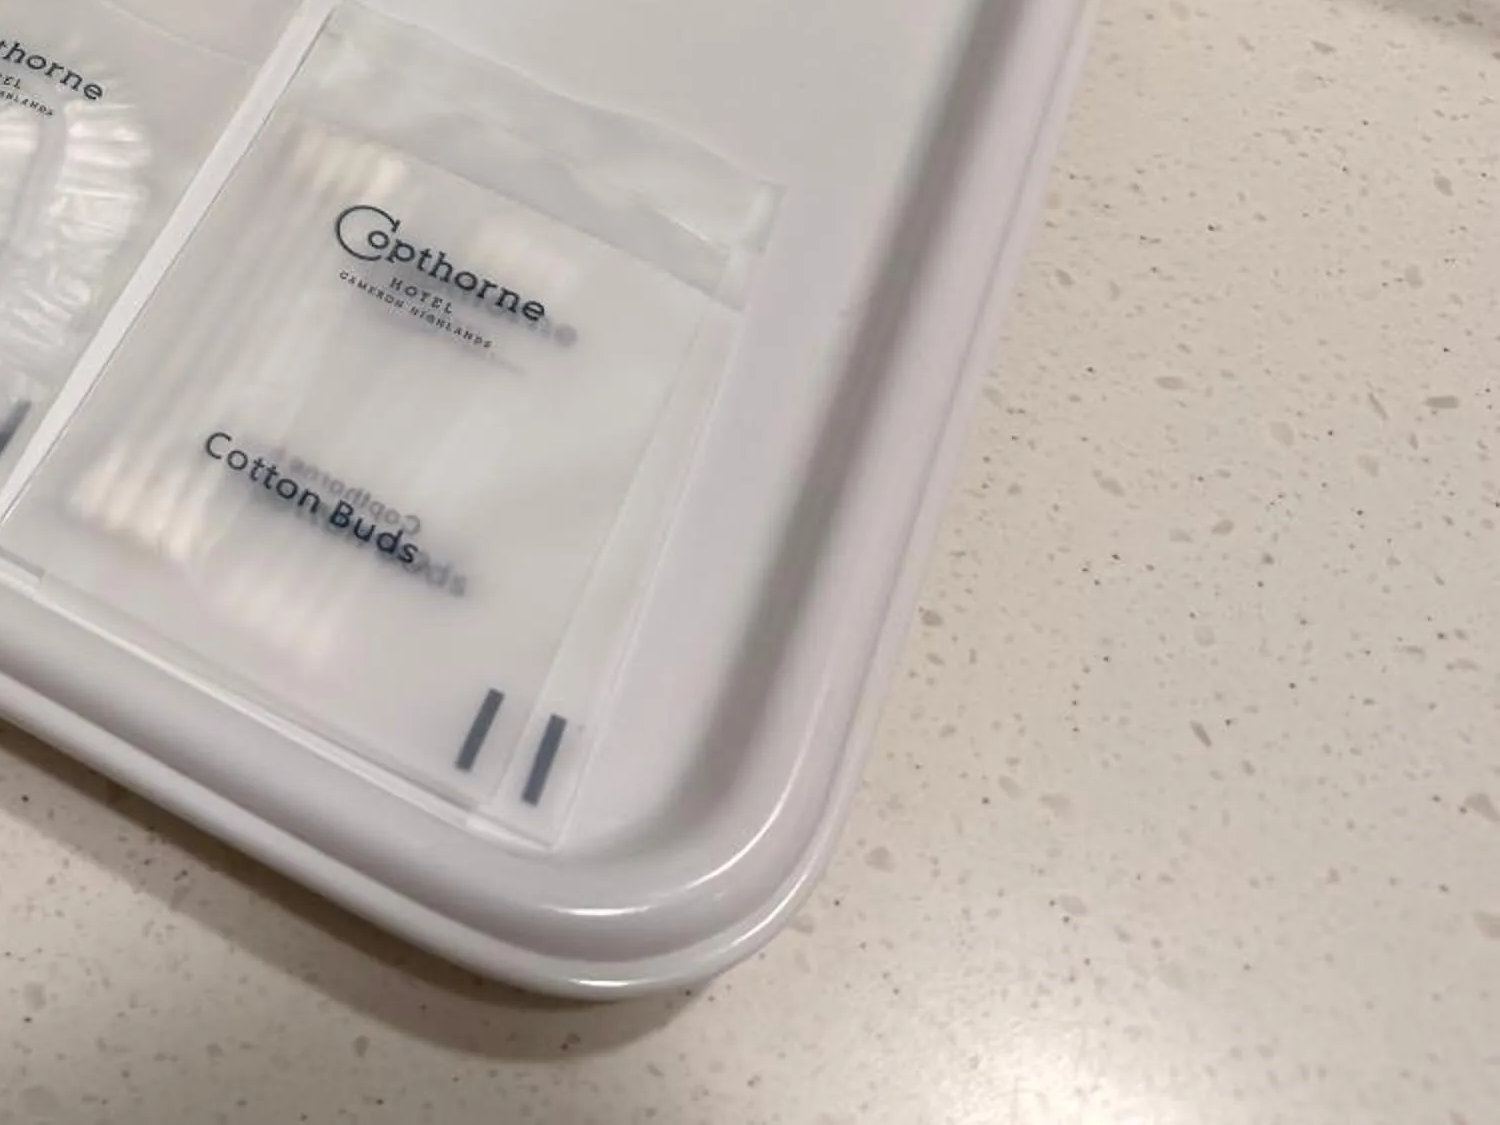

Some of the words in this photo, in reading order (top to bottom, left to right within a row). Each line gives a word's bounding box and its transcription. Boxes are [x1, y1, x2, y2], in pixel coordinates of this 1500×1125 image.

[336, 204, 546, 322] Copthorne
[339, 269, 404, 308] CAMERON
[410, 305, 493, 349] HIGHLANDS
[389, 277, 453, 315] HOTEL
[204, 431, 322, 515] Cotton
[329, 499, 420, 565] Buds
